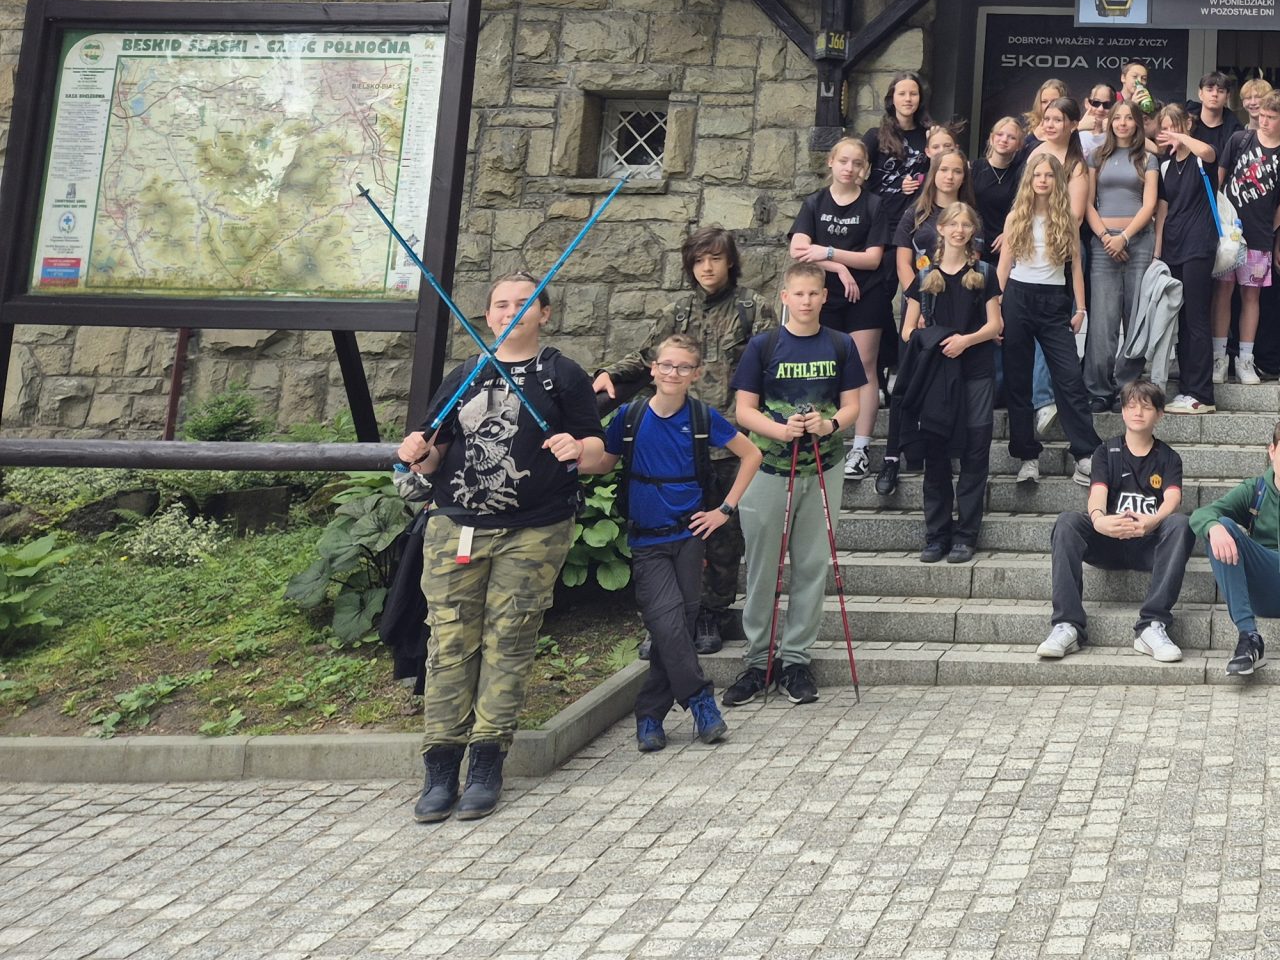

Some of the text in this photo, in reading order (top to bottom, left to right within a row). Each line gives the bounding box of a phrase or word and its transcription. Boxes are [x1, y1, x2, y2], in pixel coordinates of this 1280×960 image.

[1210, 8, 1259, 16] POZOSTAŁE
[1260, 8, 1275, 16] DNI
[121, 38, 182, 52] BESKID
[323, 37, 411, 54] PÓŁNOCNA
[1008, 36, 1052, 45] DOBRYCH
[1055, 35, 1095, 46] WRAŻEŃ
[1107, 38, 1136, 46] JAZDY
[1138, 36, 1168, 47] ŻYCZY
[776, 360, 837, 379] ATHLETIC
[1120, 496, 1156, 516] AIG
